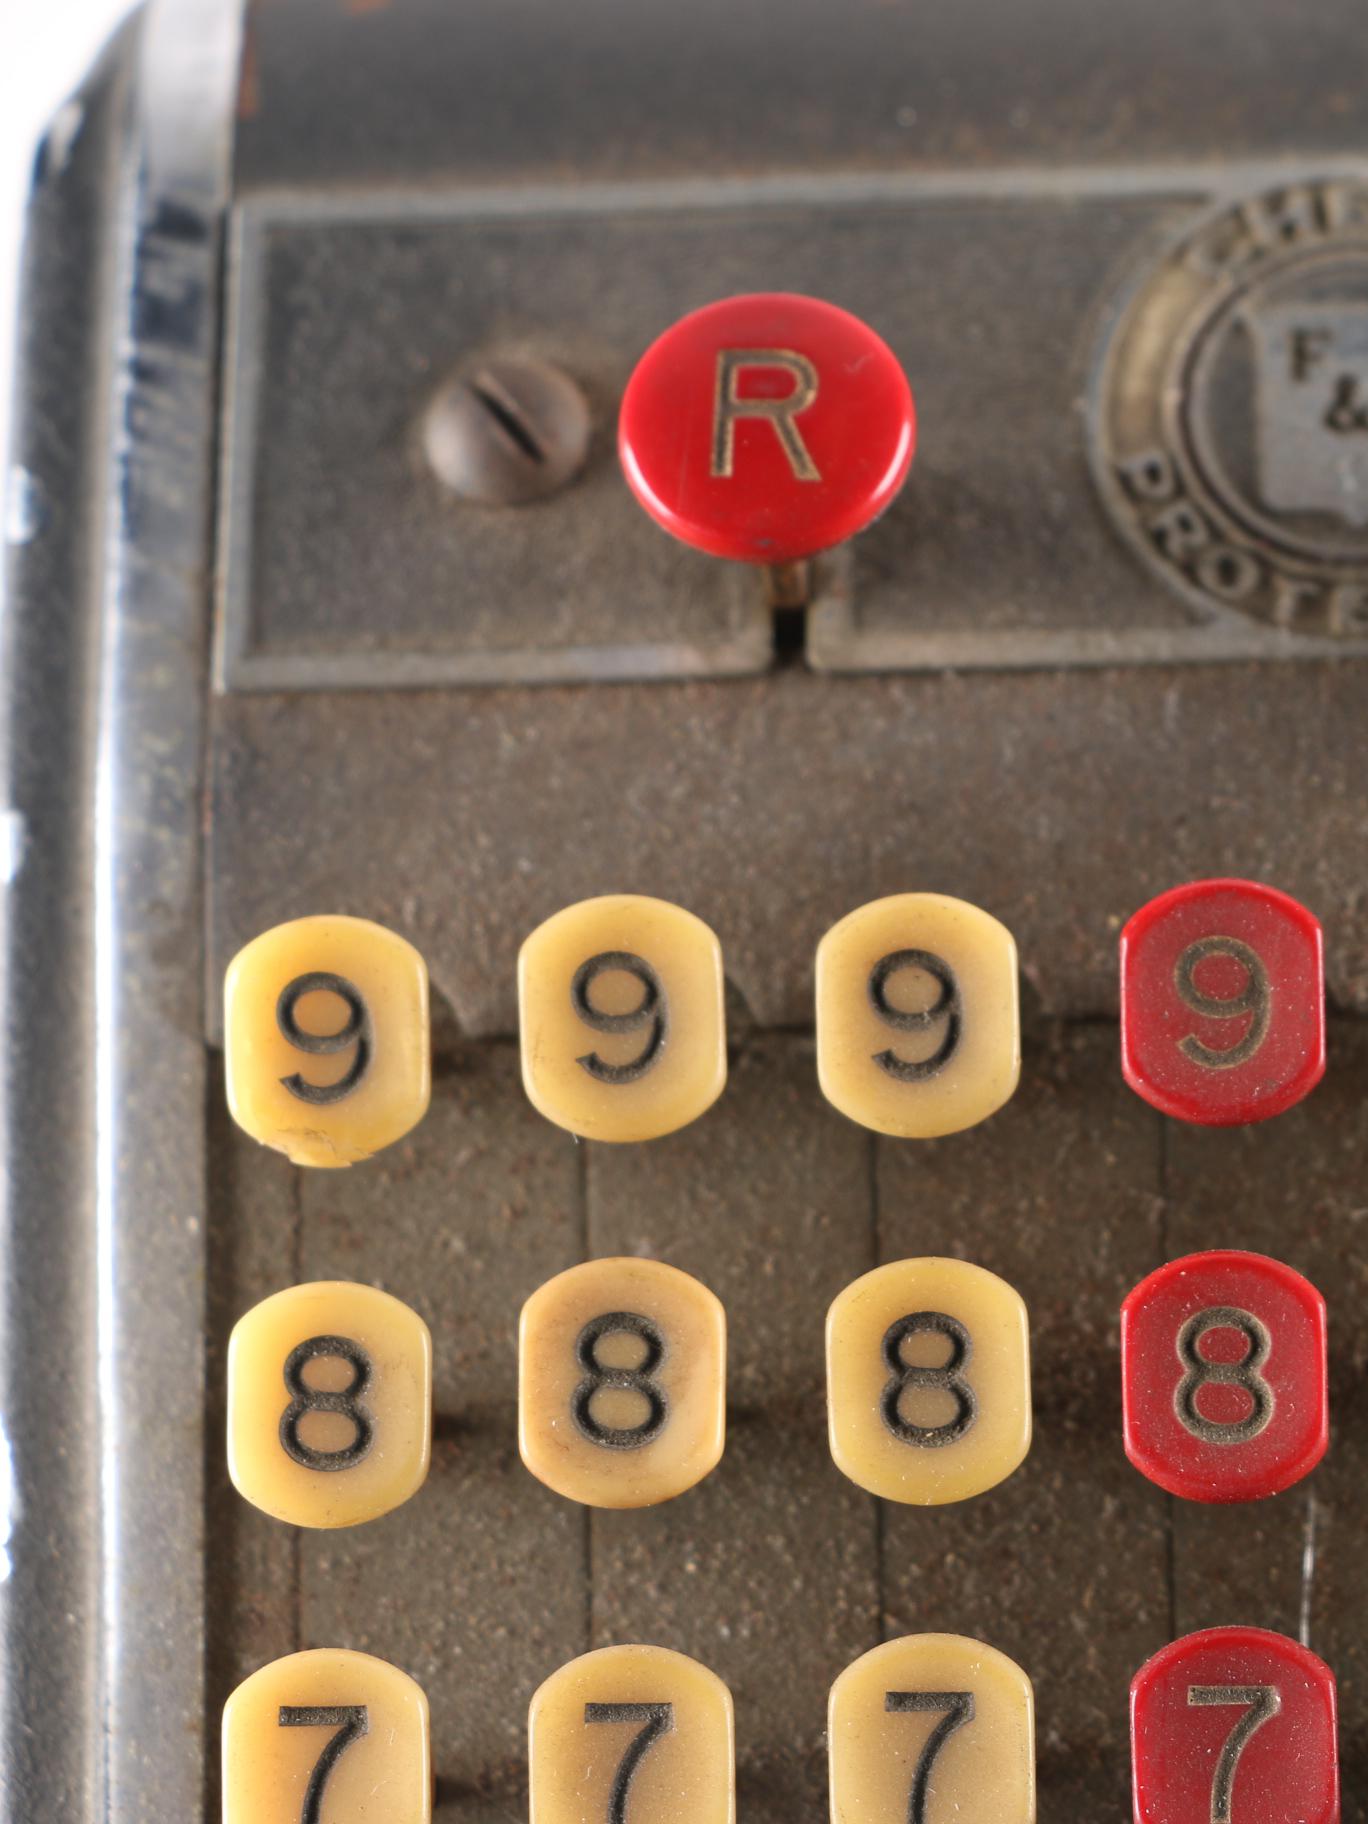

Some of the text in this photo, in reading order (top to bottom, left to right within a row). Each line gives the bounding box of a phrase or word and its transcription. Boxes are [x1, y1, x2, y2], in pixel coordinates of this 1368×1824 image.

[710, 347, 822, 480] R
[1290, 325, 1331, 383] F
[276, 972, 372, 1105] 9
[571, 951, 667, 1083] 9
[868, 949, 962, 1082] 9
[1174, 935, 1271, 1069] 9
[280, 1335, 373, 1471] 8
[571, 1311, 667, 1449] 8
[880, 1311, 977, 1446] 8
[1174, 1307, 1273, 1443] 8
[279, 1705, 367, 1824] 7
[584, 1702, 673, 1824] 7
[885, 1691, 975, 1824] 7
[1187, 1685, 1281, 1823] 7
